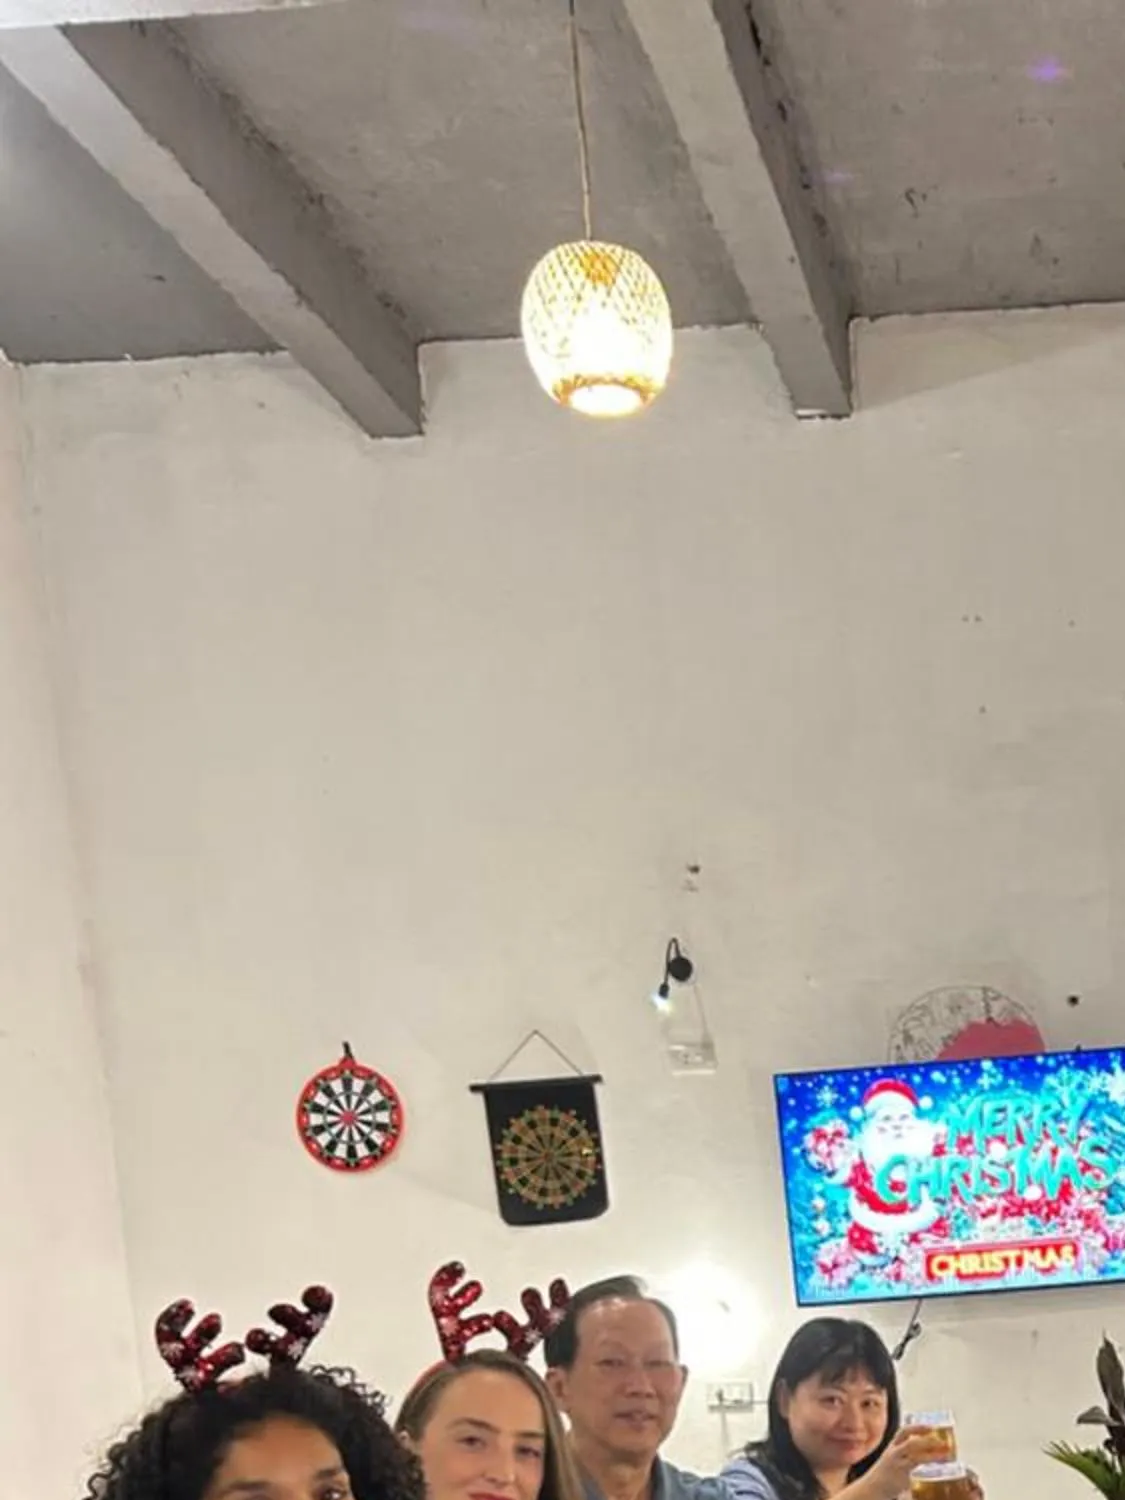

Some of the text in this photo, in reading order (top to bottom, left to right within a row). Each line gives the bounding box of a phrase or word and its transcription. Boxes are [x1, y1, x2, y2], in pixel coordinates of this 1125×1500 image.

[945, 1095, 1088, 1149] MERRY
[876, 1138, 1119, 1203] CHRISTMAS
[930, 1247, 1077, 1277] CHRISTMAS
